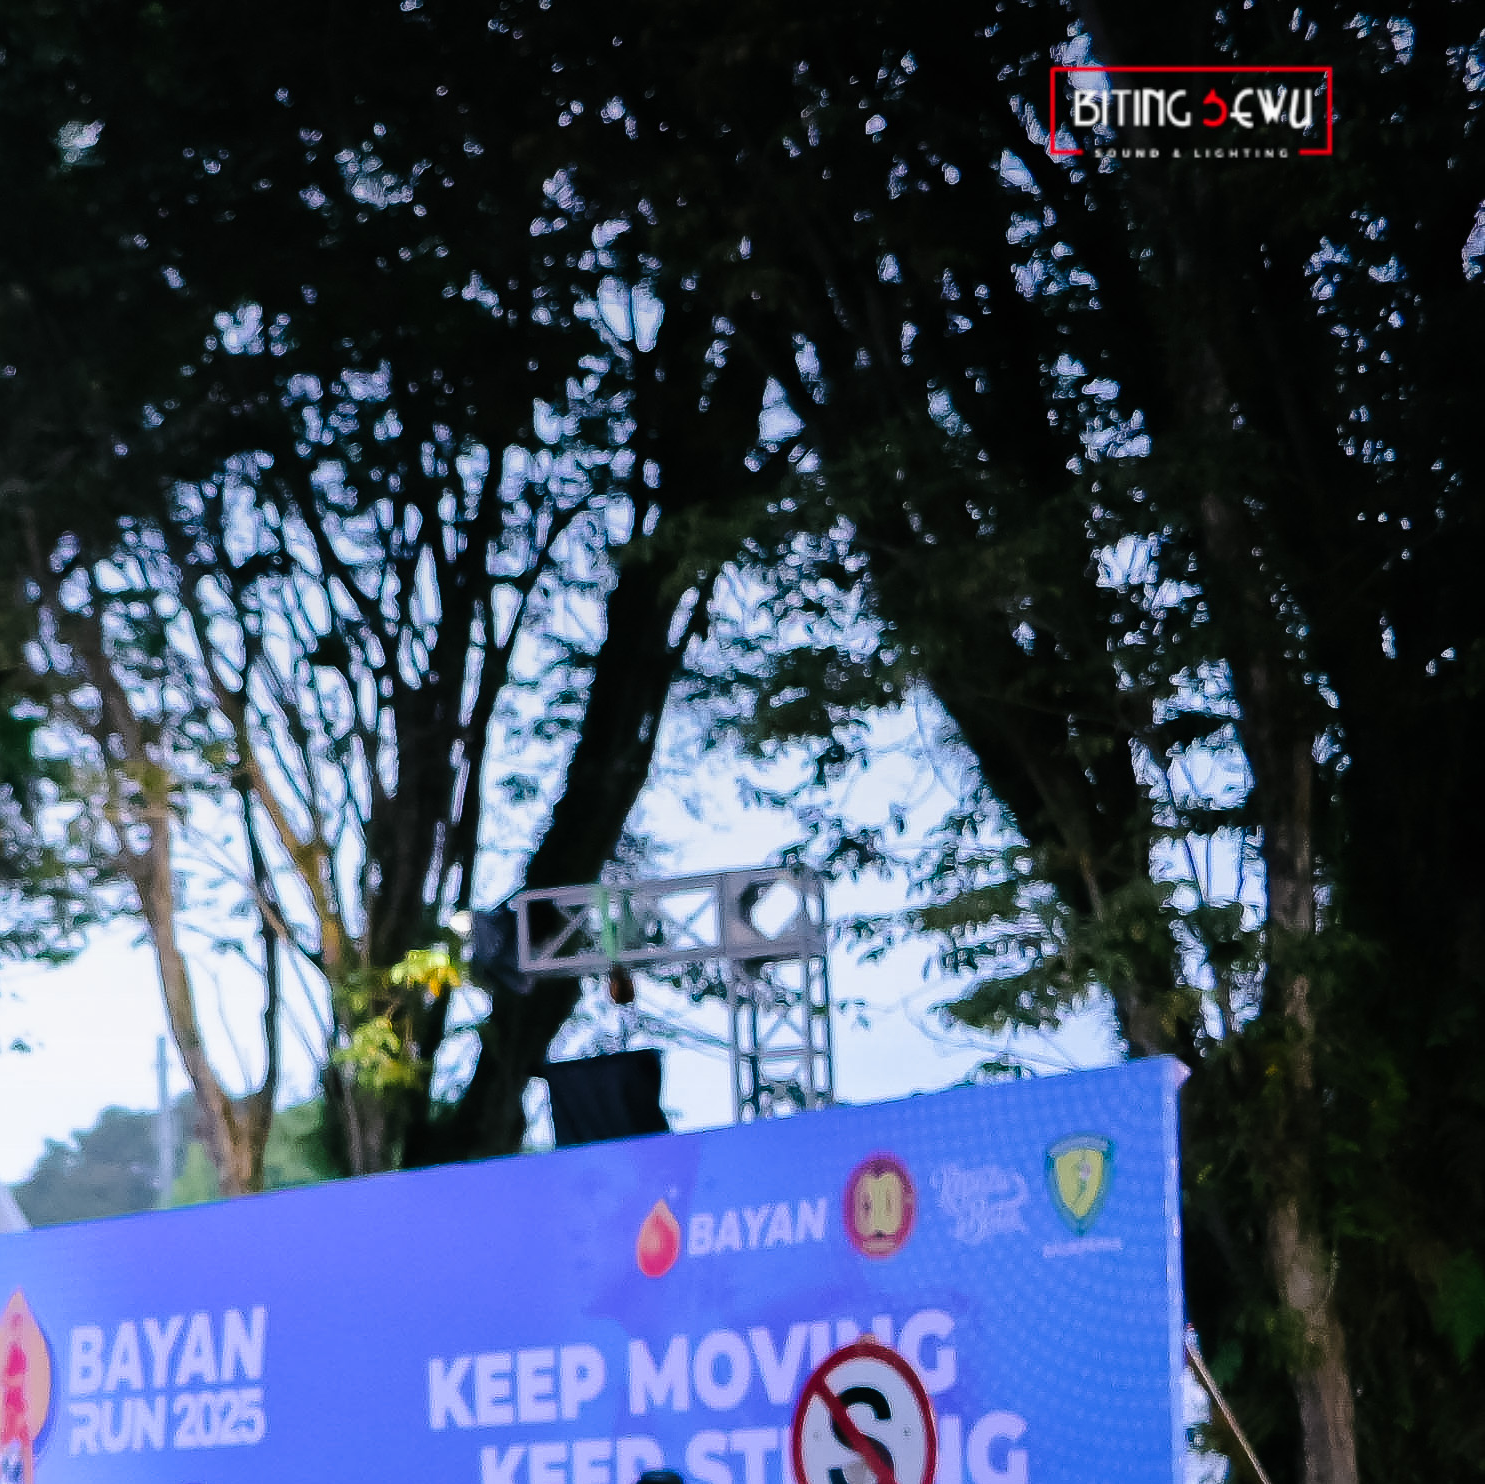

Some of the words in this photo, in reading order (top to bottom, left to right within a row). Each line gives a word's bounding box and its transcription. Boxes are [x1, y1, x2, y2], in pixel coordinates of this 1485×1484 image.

[686, 1197, 828, 1257] BAYAN
[68, 1303, 270, 1396] BAYAN
[427, 1343, 606, 1431] KEEP
[69, 1396, 168, 1457] RUN
[172, 1386, 267, 1450] 2025
